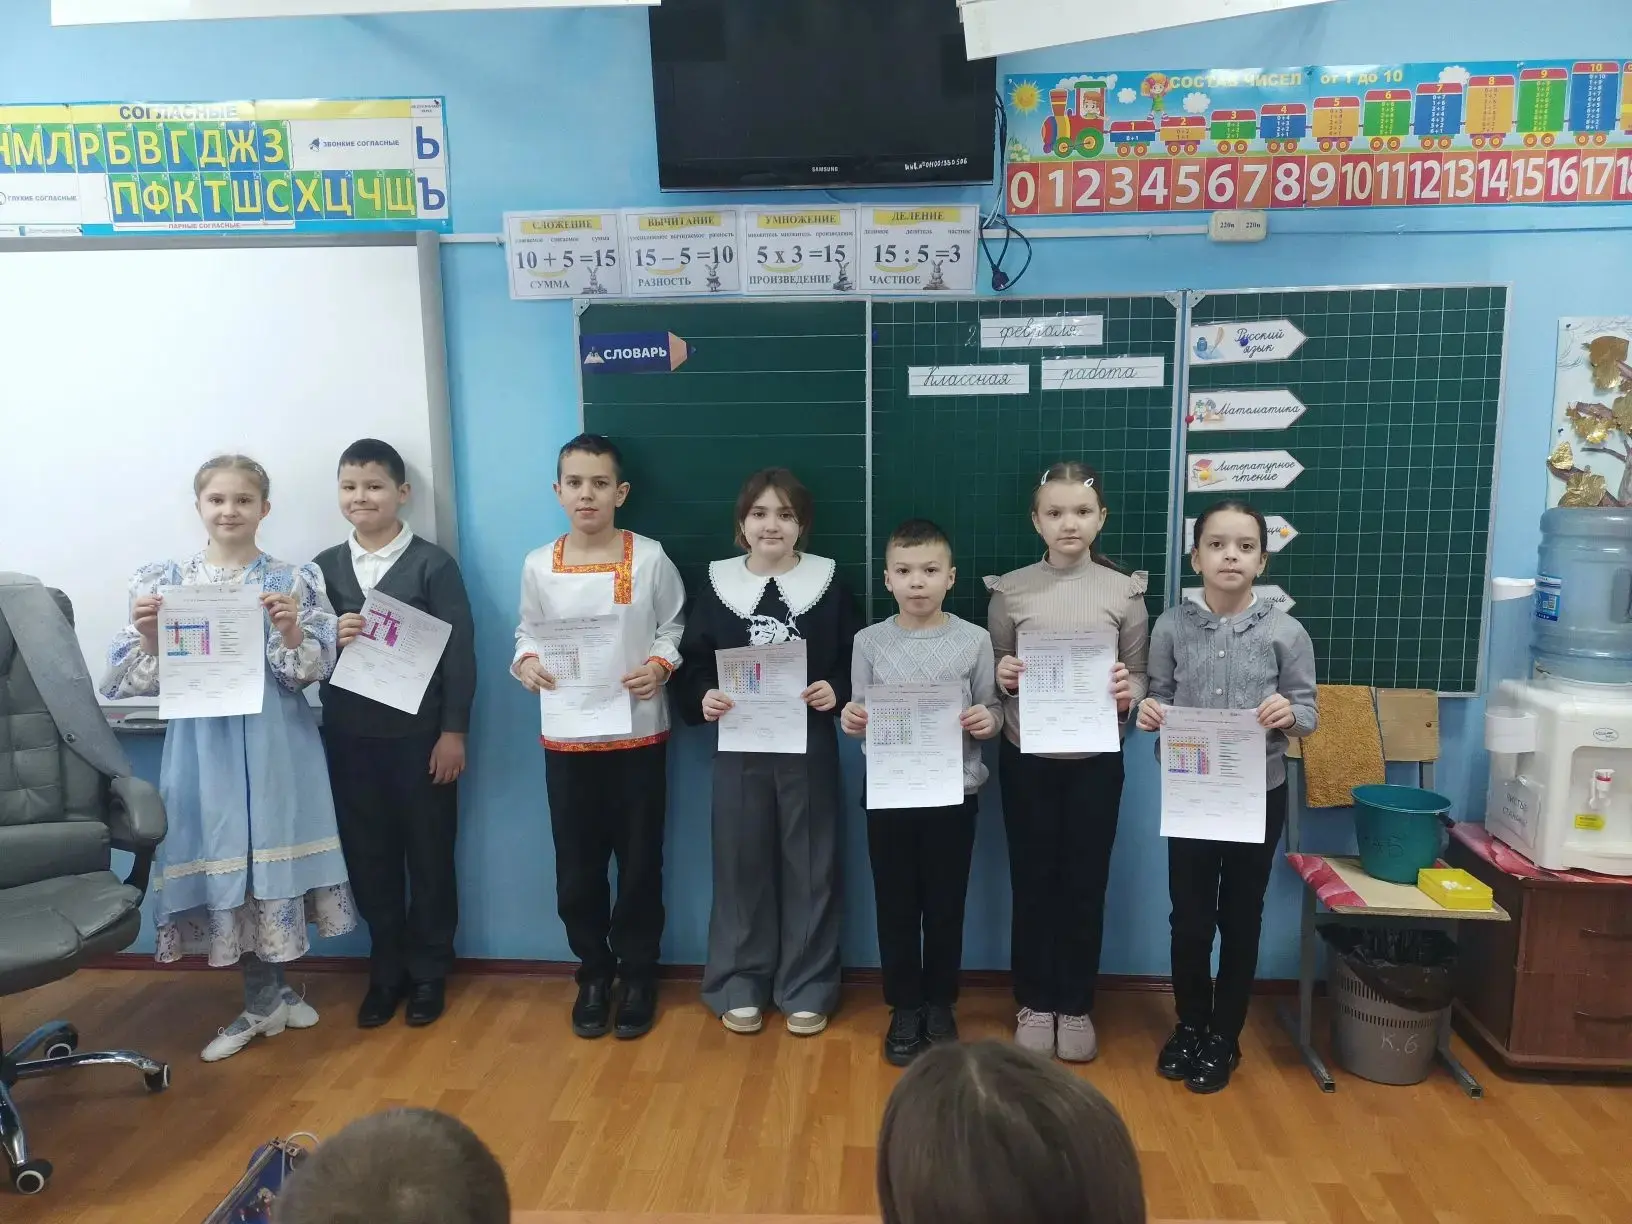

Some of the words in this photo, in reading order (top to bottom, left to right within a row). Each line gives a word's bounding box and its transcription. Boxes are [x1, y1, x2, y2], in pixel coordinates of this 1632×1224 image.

[1591, 63, 1603, 72] 10
[1169, 75, 1237, 88] СОСТАВ
[1244, 72, 1302, 87] ЧИСЕЛ
[1320, 75, 1338, 85] от
[1345, 73, 1352, 84] 1
[1357, 73, 1378, 86] до
[1384, 70, 1402, 83] 10
[1540, 70, 1548, 78] 9
[1488, 76, 1495, 86] 8
[1436, 84, 1444, 92] 7
[1385, 91, 1392, 99] 6
[1334, 98, 1340, 106] 5
[119, 105, 237, 120] СОГЛАСНЫЕ
[1280, 106, 1288, 114] 4
[1230, 111, 1237, 120] 3
[1130, 122, 1135, 130] 1
[1180, 118, 1186, 126] 2
[13, 132, 42, 165] М
[46, 132, 74, 166] Л
[79, 132, 100, 166] Р
[107, 132, 131, 165] Б
[137, 131, 162, 165] В
[170, 130, 188, 164] Г
[200, 130, 226, 168] Д
[228, 130, 258, 163] Ж
[262, 128, 284, 163] З
[416, 126, 440, 160] Ь
[1010, 171, 1036, 208] 0
[1048, 170, 1064, 208] 1
[1075, 168, 1101, 208] 2
[1109, 167, 1134, 206] 3
[1140, 166, 1168, 204] 4
[1175, 165, 1200, 204] 5
[1208, 164, 1235, 202] 6
[1242, 164, 1268, 202] 7
[1274, 162, 1301, 202] 8
[1310, 162, 1336, 200] 9
[1341, 162, 1373, 200] 10
[1376, 161, 1406, 200] 11
[1410, 160, 1440, 199] 12
[1444, 159, 1474, 198] 13
[1478, 159, 1508, 197] 14
[1512, 158, 1544, 197] 15
[1546, 156, 1580, 196] 16
[1582, 156, 1614, 194] 17
[112, 181, 140, 214] П
[143, 180, 170, 214] Ф
[174, 181, 198, 214] К
[204, 180, 226, 214] Т
[232, 180, 262, 213] Ш
[266, 179, 290, 213] С
[296, 178, 320, 212] Х
[324, 178, 352, 216] Ц
[358, 178, 381, 210] Ч
[386, 178, 416, 216] Щ
[417, 177, 446, 210] Ъ
[766, 215, 836, 225] УМНОЖЕНИЕ
[892, 211, 944, 221] ДЕЛЕНИЕ
[532, 220, 592, 230] СЛОЖЕНИЕ
[648, 217, 714, 227] ВЫЧИТАНИЕ
[634, 248, 656, 266] 15
[680, 247, 691, 265] 5
[757, 246, 768, 264] 5
[792, 246, 802, 263] 3
[874, 244, 896, 262] 15
[918, 244, 929, 263] 5
[516, 251, 538, 269] 10
[544, 253, 556, 266] +
[563, 250, 574, 268] 5
[530, 280, 570, 289] СУММА
[638, 278, 692, 287] РАЗНОСТЬ
[750, 275, 832, 285] ПРОИЗВЕДЕНИЕ
[869, 276, 920, 284] ЧАСТНОЕ
[603, 346, 667, 360] СЛОВАРЬ
[1243, 345, 1274, 358] язык
[924, 366, 1012, 387] Классная
[1060, 358, 1138, 389] работа
[1215, 402, 1300, 416] Математика
[1214, 460, 1296, 474] Литературное
[1232, 473, 1278, 482] чтение
